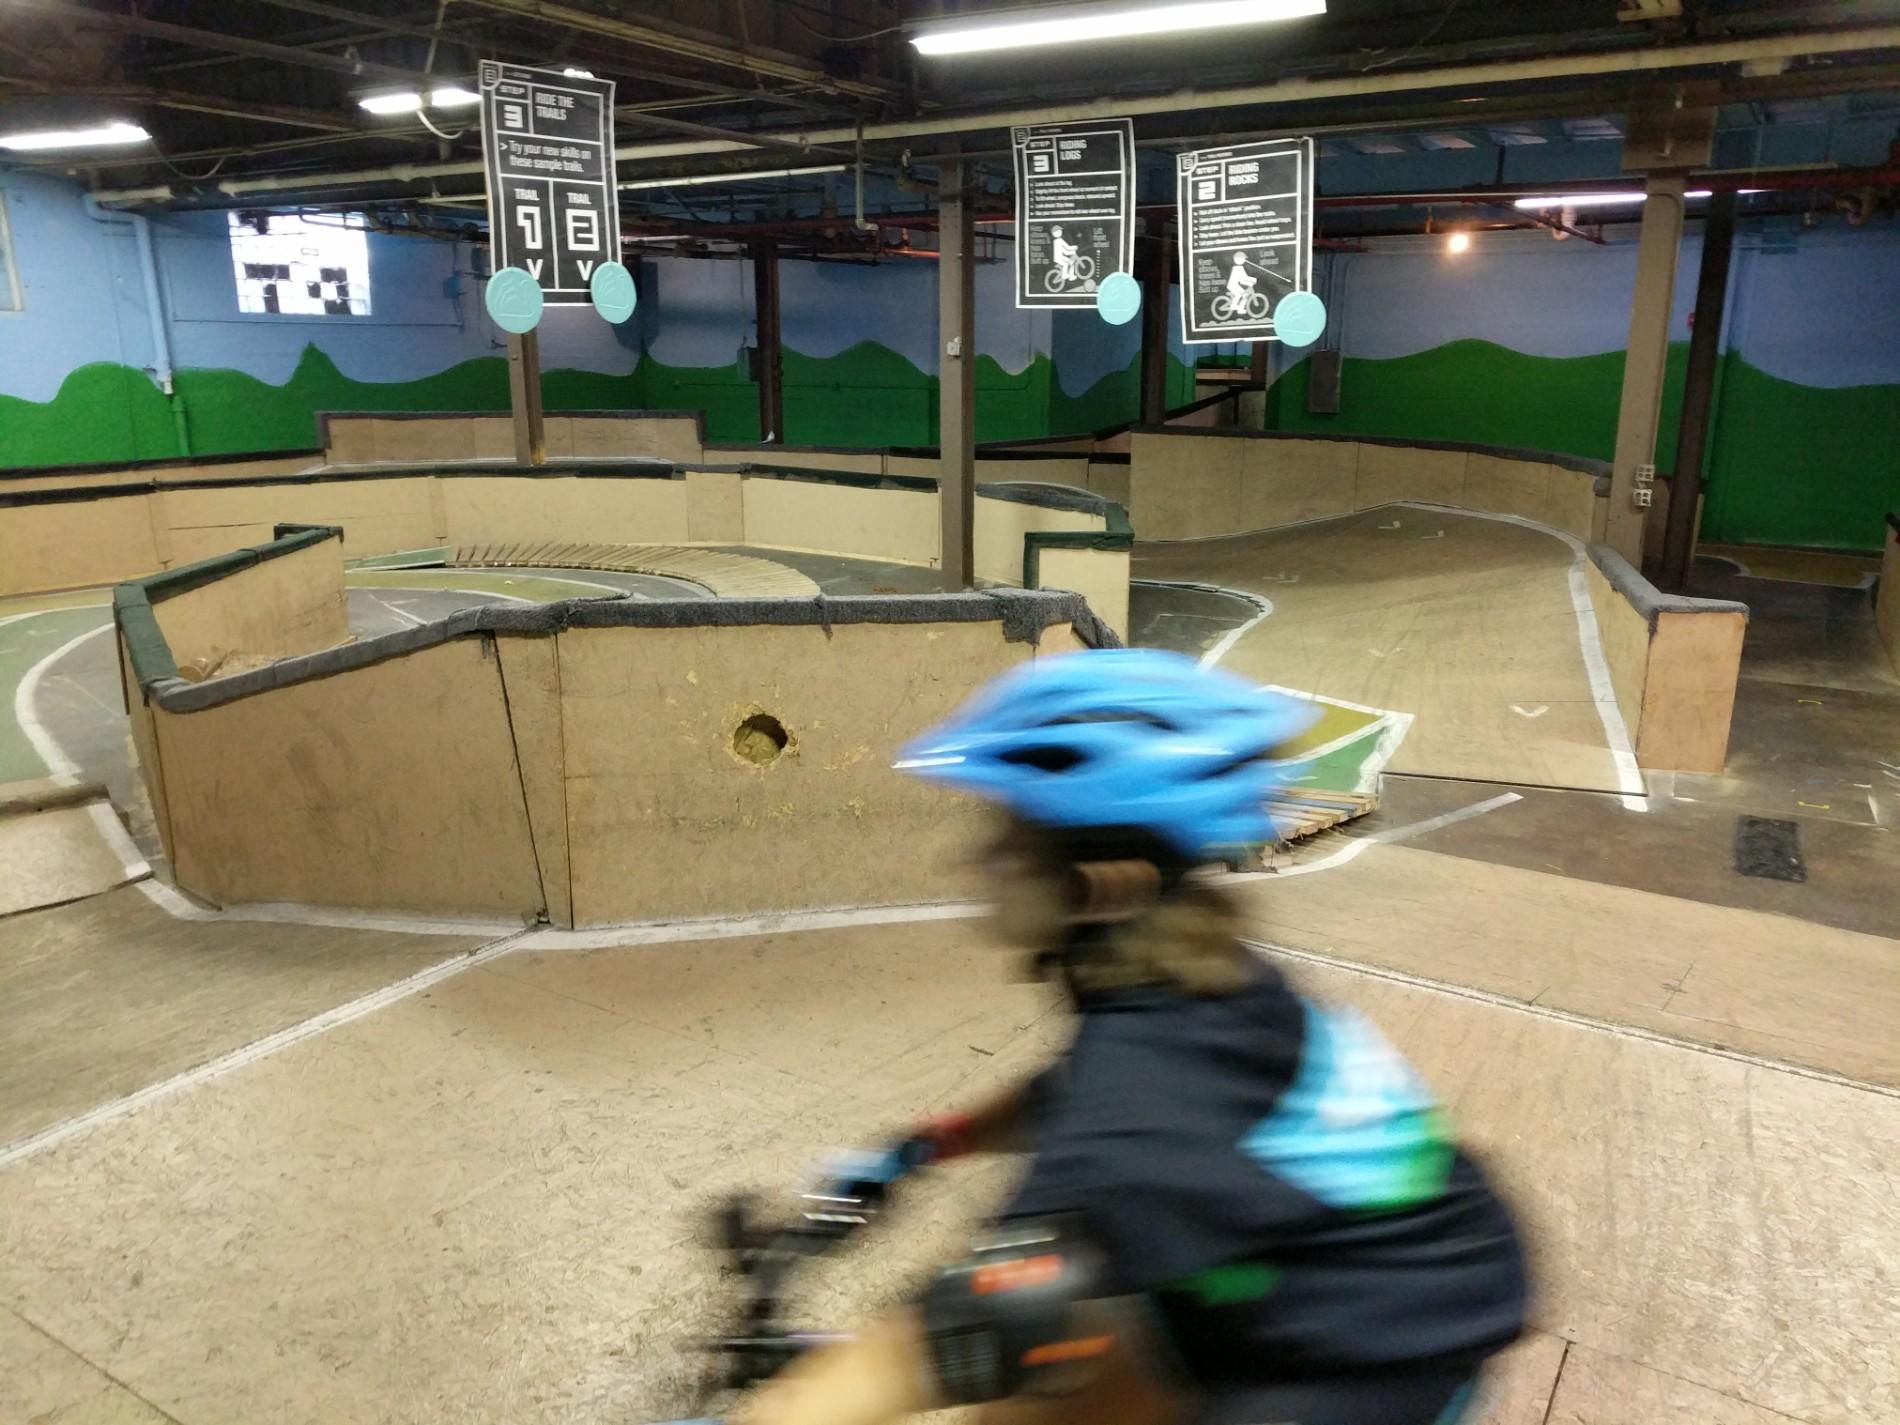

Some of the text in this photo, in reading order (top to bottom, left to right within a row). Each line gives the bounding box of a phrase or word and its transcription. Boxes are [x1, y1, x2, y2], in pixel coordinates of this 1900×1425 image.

[535, 92, 575, 109] RIDE THE
[535, 105, 567, 120] TRAILS
[508, 140, 592, 160] Try your new skills on
[1059, 139, 1087, 150] RIDING
[1060, 150, 1082, 160] LOGS
[508, 155, 533, 167] these
[533, 159, 562, 172] sample
[1228, 161, 1260, 175] RIDING
[1228, 173, 1259, 186] ROCKS
[513, 188, 540, 201] TRAIL
[566, 192, 592, 205] TRAIL
[516, 205, 543, 249] 1
[565, 208, 600, 251] 2
